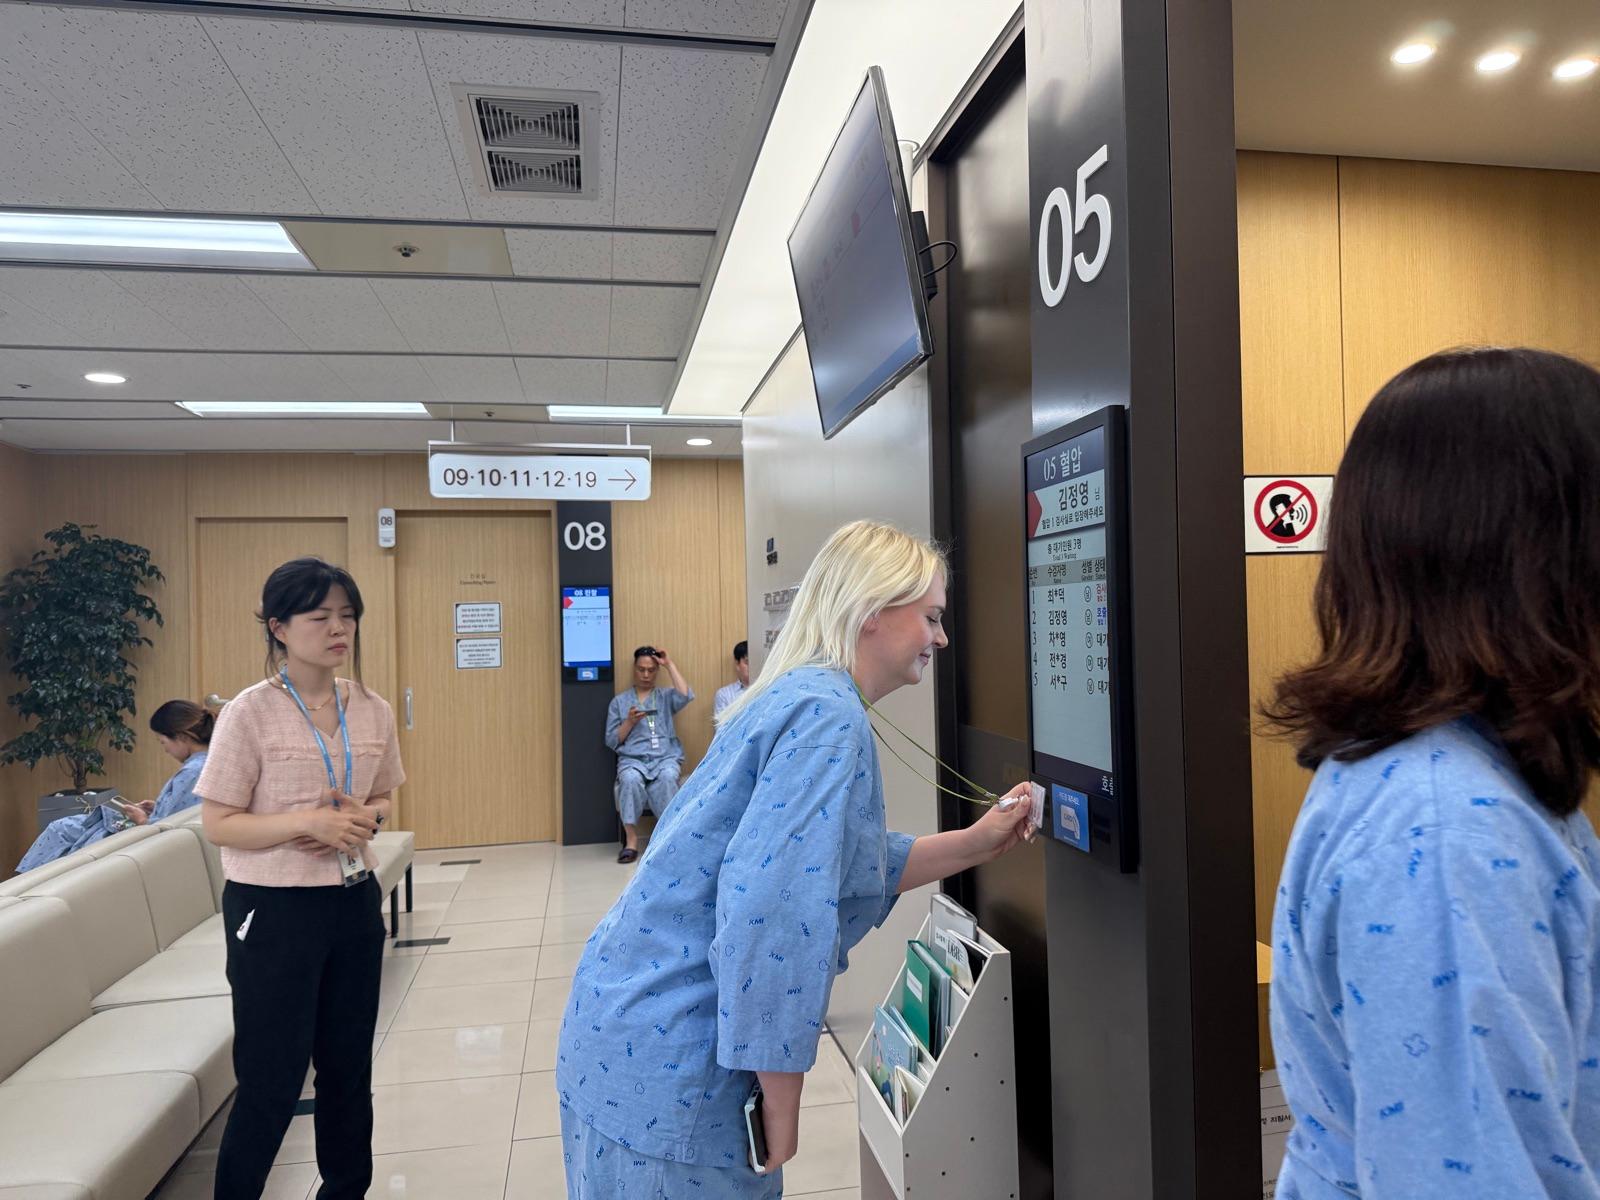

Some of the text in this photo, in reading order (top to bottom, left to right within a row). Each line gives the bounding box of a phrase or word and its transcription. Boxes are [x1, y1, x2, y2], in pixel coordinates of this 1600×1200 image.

[1039, 144, 1111, 307] 05
[1043, 446, 1082, 481] 05 혈압
[443, 468, 597, 488] 09·10·11·12·19
[1059, 480, 1089, 511] 김정영
[380, 516, 393, 526] 08
[564, 521, 607, 551] 08
[1032, 610, 1036, 624] 2
[1048, 610, 1067, 625] 김정영
[1032, 631, 1037, 645] 3
[1033, 652, 1037, 666] 4
[1033, 672, 1038, 686] 5
[761, 853, 773, 869] KMI
[805, 865, 821, 873] KMI
[748, 917, 764, 926] KMI
[638, 927, 653, 935] KMI
[768, 951, 784, 963] KMI
[787, 986, 802, 995] KMI
[653, 1023, 668, 1036] KMI
[733, 1043, 749, 1052] KMI
[676, 1099, 692, 1109] KMI
[1379, 1101, 1404, 1120] KMI
[646, 1116, 658, 1131] KMI
